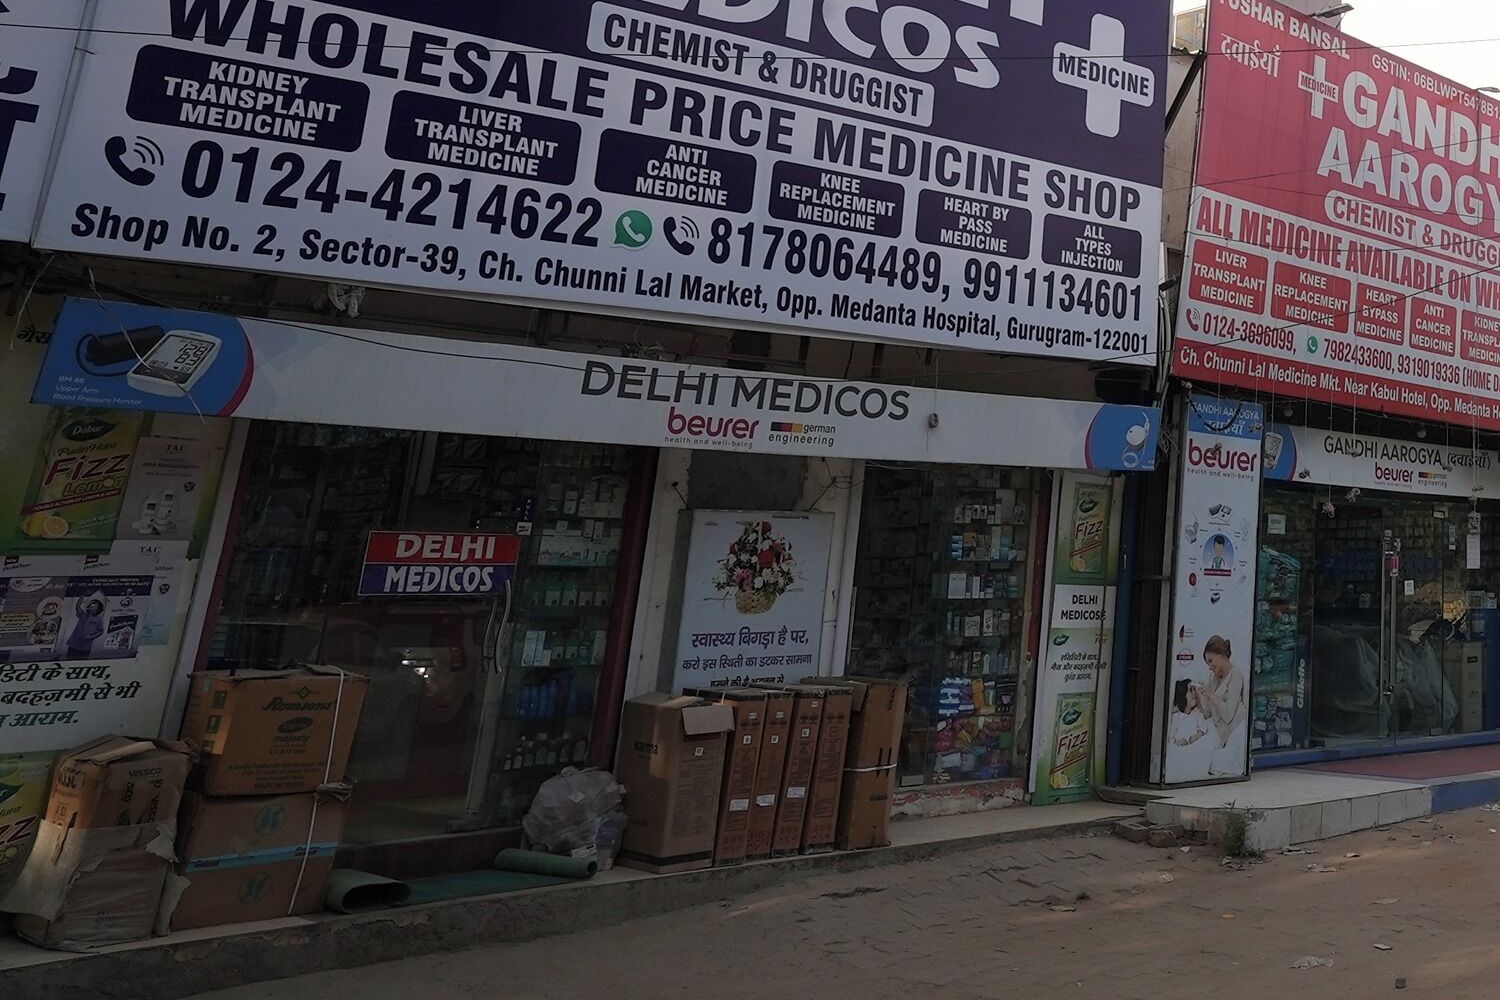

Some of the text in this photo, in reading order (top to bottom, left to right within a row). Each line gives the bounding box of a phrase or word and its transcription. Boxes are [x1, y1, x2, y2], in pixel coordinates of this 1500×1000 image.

[1289, 17, 1351, 60] BANSAL
[208, 62, 309, 93] KIDNEY
[604, 13, 923, 118] CHEMIST & DRUGGIST
[1058, 52, 1150, 99] MEDICINE
[1372, 53, 1411, 83] GSTIN:
[164, 76, 341, 123] TRANSPLANT
[1301, 75, 1337, 100] MEDICINE
[179, 103, 317, 142] MEDICINE
[459, 106, 523, 133] LIVER
[414, 119, 558, 159] TRANSPLANT
[629, 77, 795, 154] PRICE
[814, 118, 1030, 202] MEDICINE
[1043, 169, 1140, 223] SHOP
[427, 142, 539, 177] MEDICINE
[665, 144, 708, 166] ANTI
[646, 159, 722, 187] CANCER
[820, 172, 861, 195] KNEE
[635, 177, 728, 207] MEDICINE
[779, 183, 896, 218] REPLACEMENT
[797, 204, 876, 231] MEDICINE
[944, 198, 1010, 222] HEART BY
[1333, 198, 1418, 239] CHEMIST
[1421, 224, 1434, 246] &
[181, 139, 1143, 322] 0124-4214622 8178064489, 9911134601
[958, 217, 993, 237] PASS
[1084, 224, 1105, 240] ALL
[940, 230, 1008, 254] MEDICINE
[1075, 237, 1112, 257] TYPES
[1196, 196, 1233, 237] ALL
[1238, 207, 1341, 269] MEDICINE
[1345, 237, 1445, 296] AVAILABLE
[1448, 268, 1472, 302] ON
[1061, 250, 1124, 273] INJECTION
[1215, 250, 1248, 270] LIVER
[71, 202, 1149, 354] Shop No. 2, Sector-39, Ch. Chunni Lal Market, Opp. Medanta Hospital, Gurugram-122001
[1193, 264, 1265, 293] TRANSPLANT
[1299, 272, 1327, 290] KNEE
[1199, 284, 1254, 309] MEDICINE
[1274, 284, 1348, 312] REPLACEMENT
[1365, 288, 1398, 307] HEART
[1285, 304, 1335, 328] MEDICINE
[1423, 303, 1445, 319] ANTI
[1356, 320, 1402, 343] MEDICINE
[1415, 317, 1452, 337] CANCER
[1411, 332, 1454, 354] MEDICINE
[1323, 337, 1395, 376] 7982433600,
[1397, 353, 1460, 384] 9319019336
[581, 360, 911, 421] DELHI MEDICOS
[1203, 350, 1246, 375] Chunni
[1248, 361, 1266, 379] Lal
[1268, 362, 1317, 388] Medicine
[1344, 375, 1369, 397] Near
[1370, 381, 1399, 402] Kabul
[1401, 387, 1428, 410] Hotel,
[1454, 397, 1491, 419] Medanta
[71, 424, 104, 436] Dabur
[667, 406, 760, 440] beurer
[803, 422, 837, 437] german
[664, 435, 691, 445] health
[693, 437, 709, 446] and
[768, 431, 835, 449] engineering
[1323, 435, 1442, 466] GANDHI AAROGYA
[1188, 438, 1258, 472] beurer
[44, 453, 131, 487] Fizz
[1374, 462, 1414, 483] beurer
[62, 476, 124, 498] Lemon
[1075, 520, 1104, 540] Fizz
[395, 533, 496, 562] DELHI
[383, 565, 494, 593] MEDICOS
[1072, 594, 1098, 605] DELHI
[1057, 730, 1089, 754] Fizz
